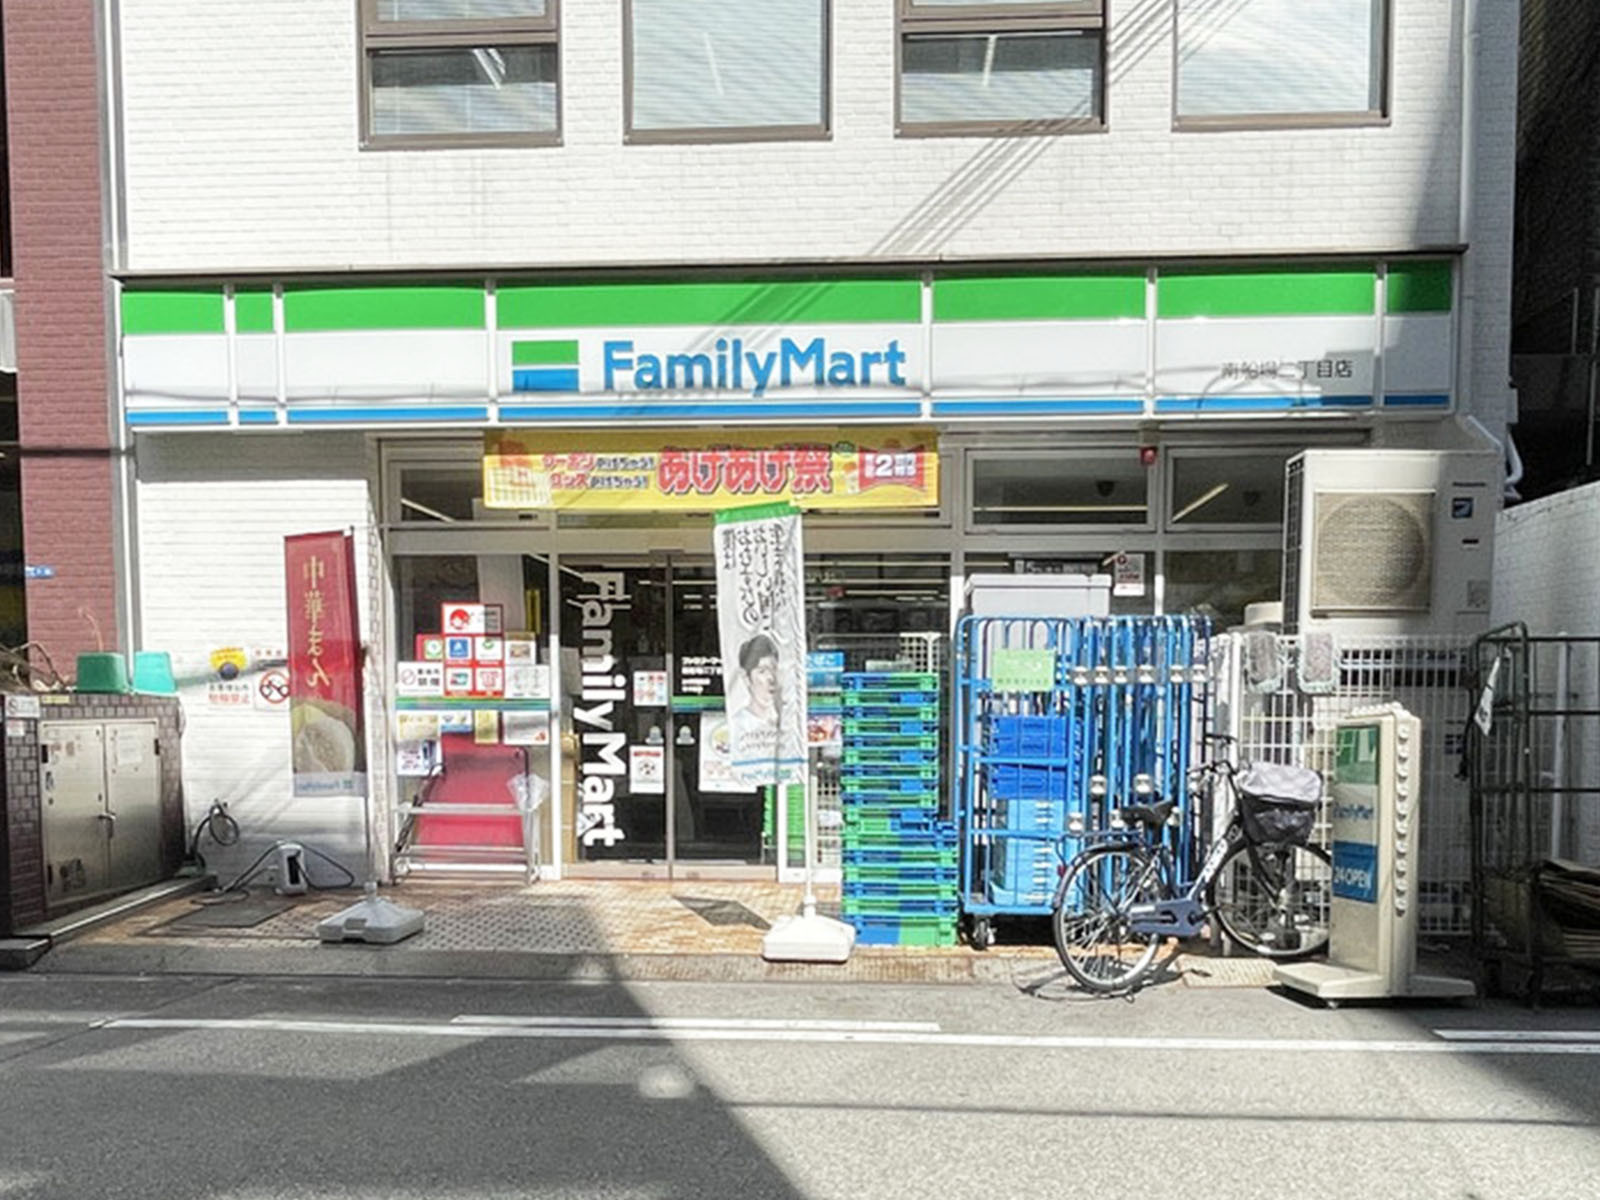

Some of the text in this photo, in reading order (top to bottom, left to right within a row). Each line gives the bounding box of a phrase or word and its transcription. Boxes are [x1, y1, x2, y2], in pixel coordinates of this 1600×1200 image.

[603, 338, 906, 397] FamilyMart
[657, 443, 833, 494] あげあげ祭
[573, 572, 627, 847] FamilyMart
